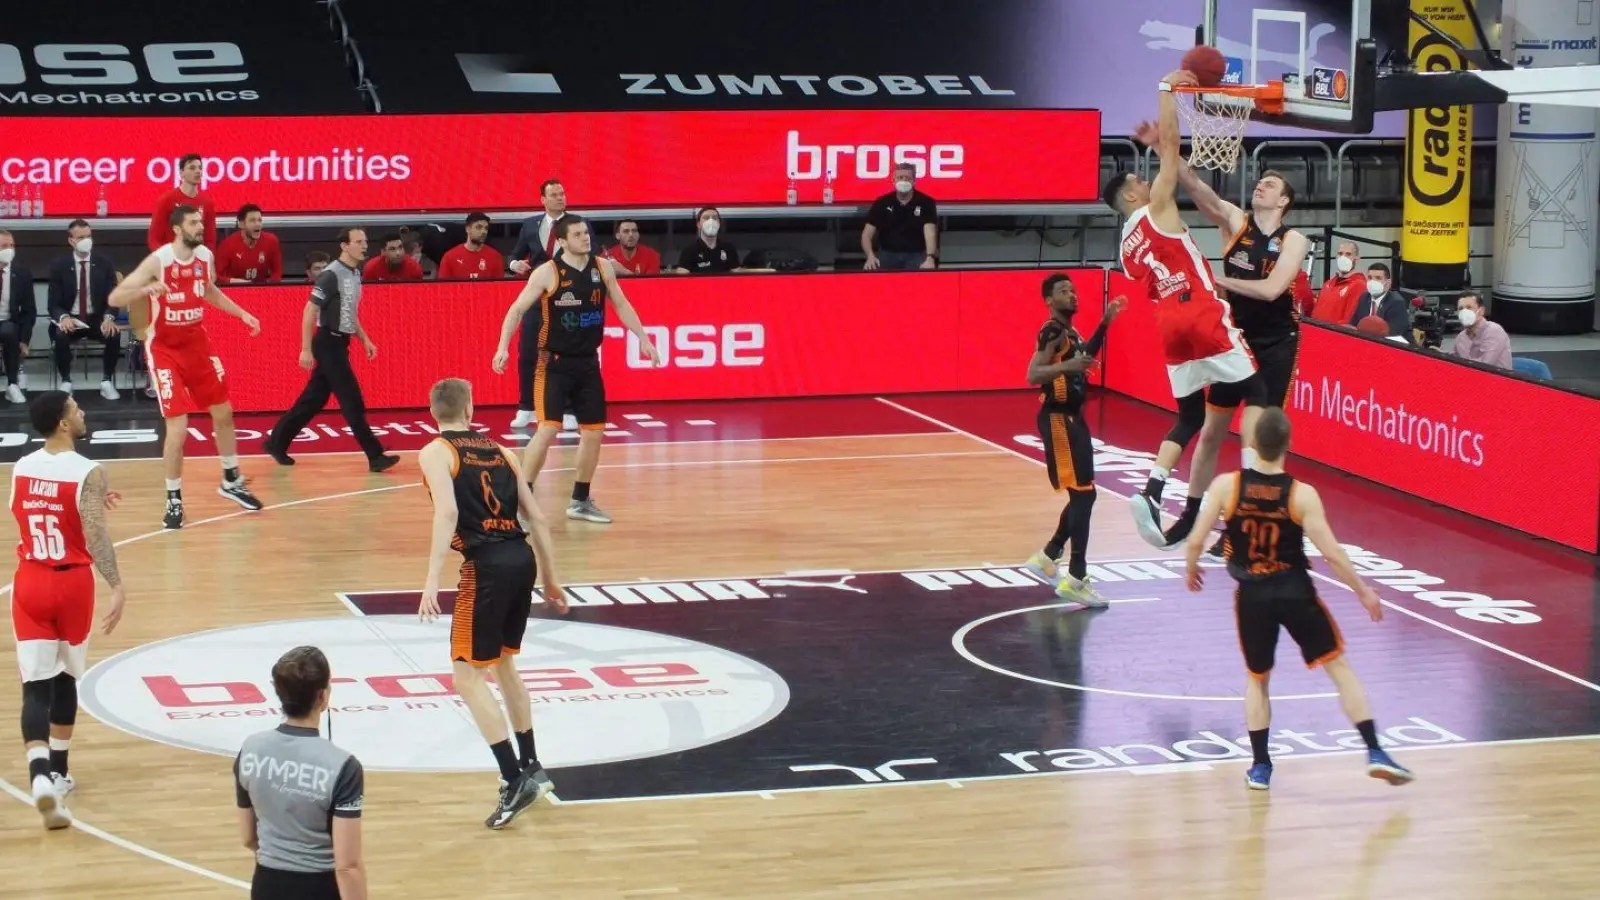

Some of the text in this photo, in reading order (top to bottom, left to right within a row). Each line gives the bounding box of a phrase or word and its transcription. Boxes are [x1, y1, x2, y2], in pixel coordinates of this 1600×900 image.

[0, 42, 249, 85] se
[1551, 36, 1597, 50] maxit
[619, 73, 1016, 96] ZUMTOBEL
[1315, 82, 1330, 95] BBL
[1423, 54, 1451, 176] rado
[2, 156, 134, 184] career
[787, 130, 964, 180] brose
[1294, 368, 1485, 467] in Mechatronics
[480, 470, 502, 516] 6
[28, 514, 66, 560] 55
[531, 579, 771, 606] UMA
[403, 700, 438, 714] in
[1000, 716, 1467, 773] randstad
[241, 753, 330, 792] GYMPER
